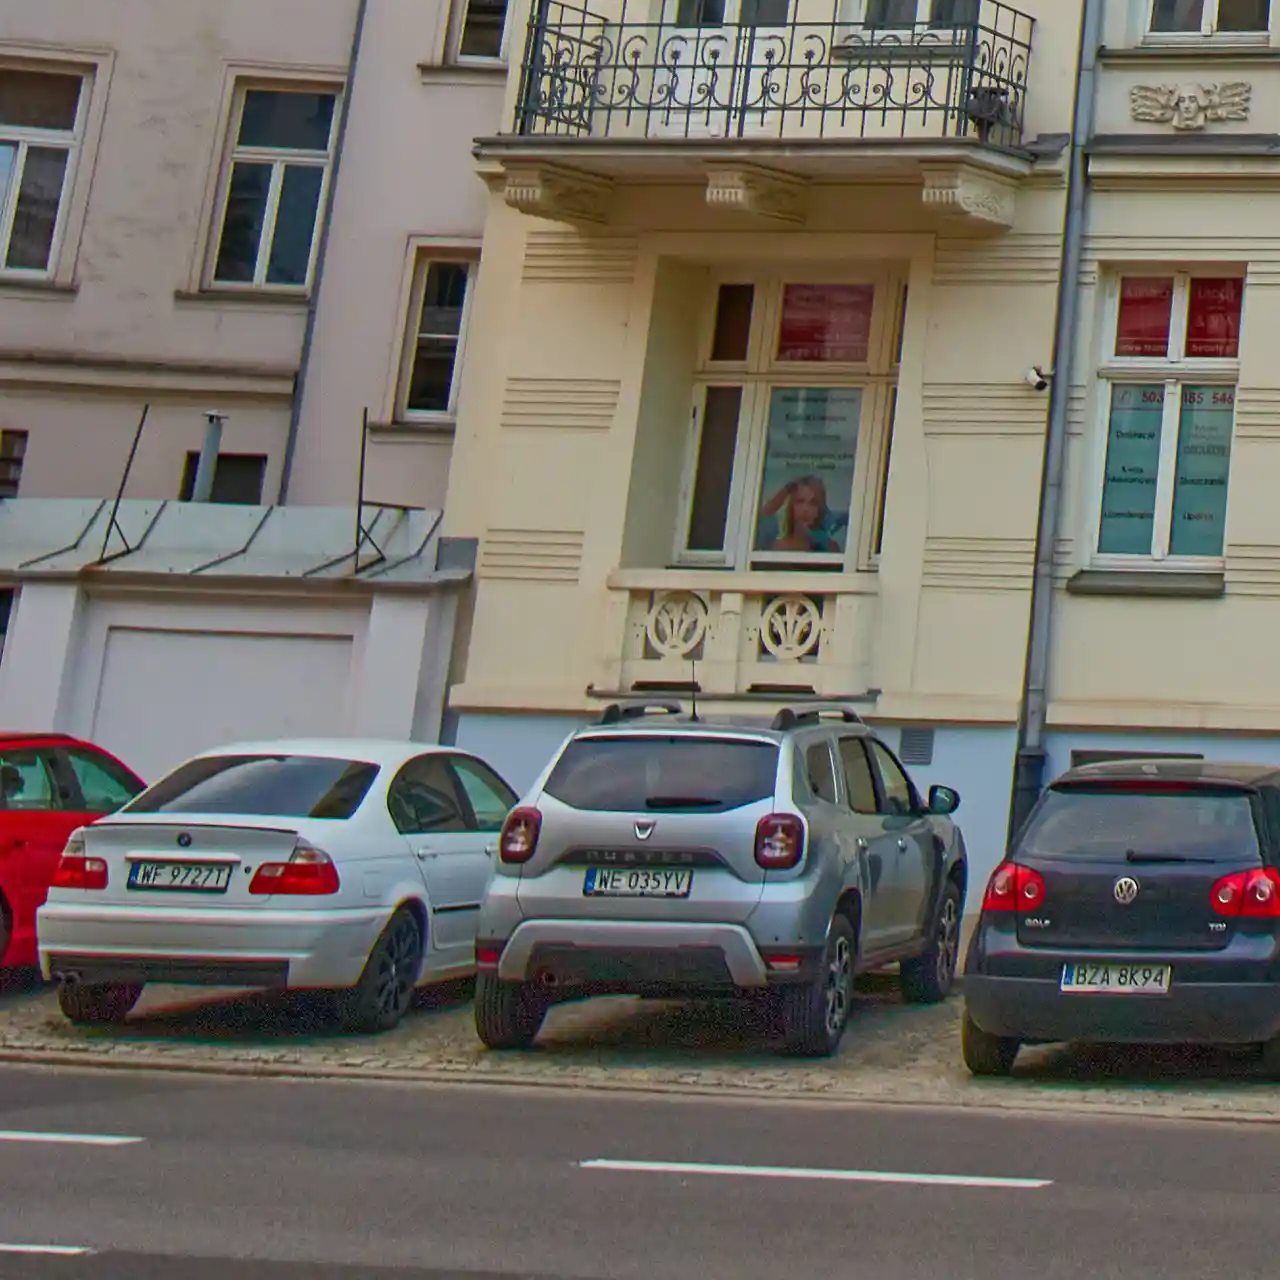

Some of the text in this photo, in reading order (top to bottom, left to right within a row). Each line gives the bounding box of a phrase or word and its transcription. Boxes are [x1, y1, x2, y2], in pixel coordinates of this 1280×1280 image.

[170, 866, 226, 888] 9727T
[599, 870, 687, 891] WE 035YV
[1075, 966, 1164, 987] BZA 8K94
